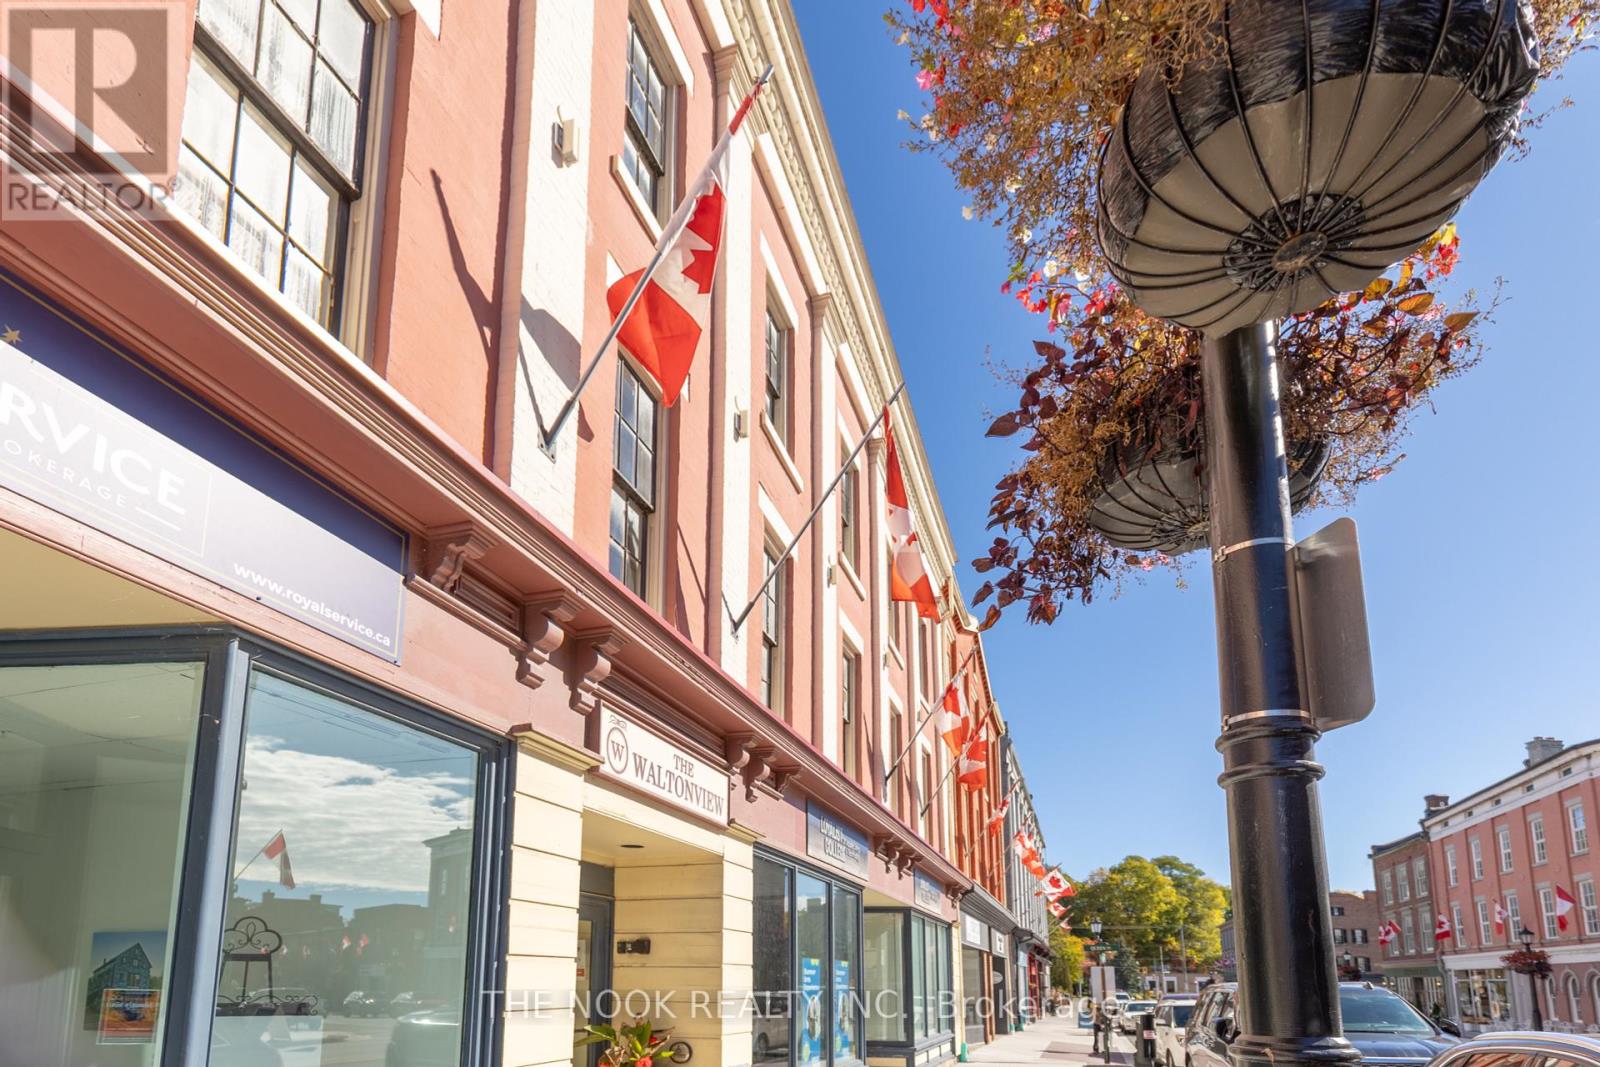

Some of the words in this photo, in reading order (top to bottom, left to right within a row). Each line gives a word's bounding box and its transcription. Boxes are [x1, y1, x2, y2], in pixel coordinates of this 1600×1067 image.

[4, 439, 128, 507] OKERAGE
[233, 563, 391, 648] www.royalservice.ca
[611, 740, 625, 762] W
[673, 753, 695, 778] THE
[632, 752, 724, 817] WALTONVIEW
